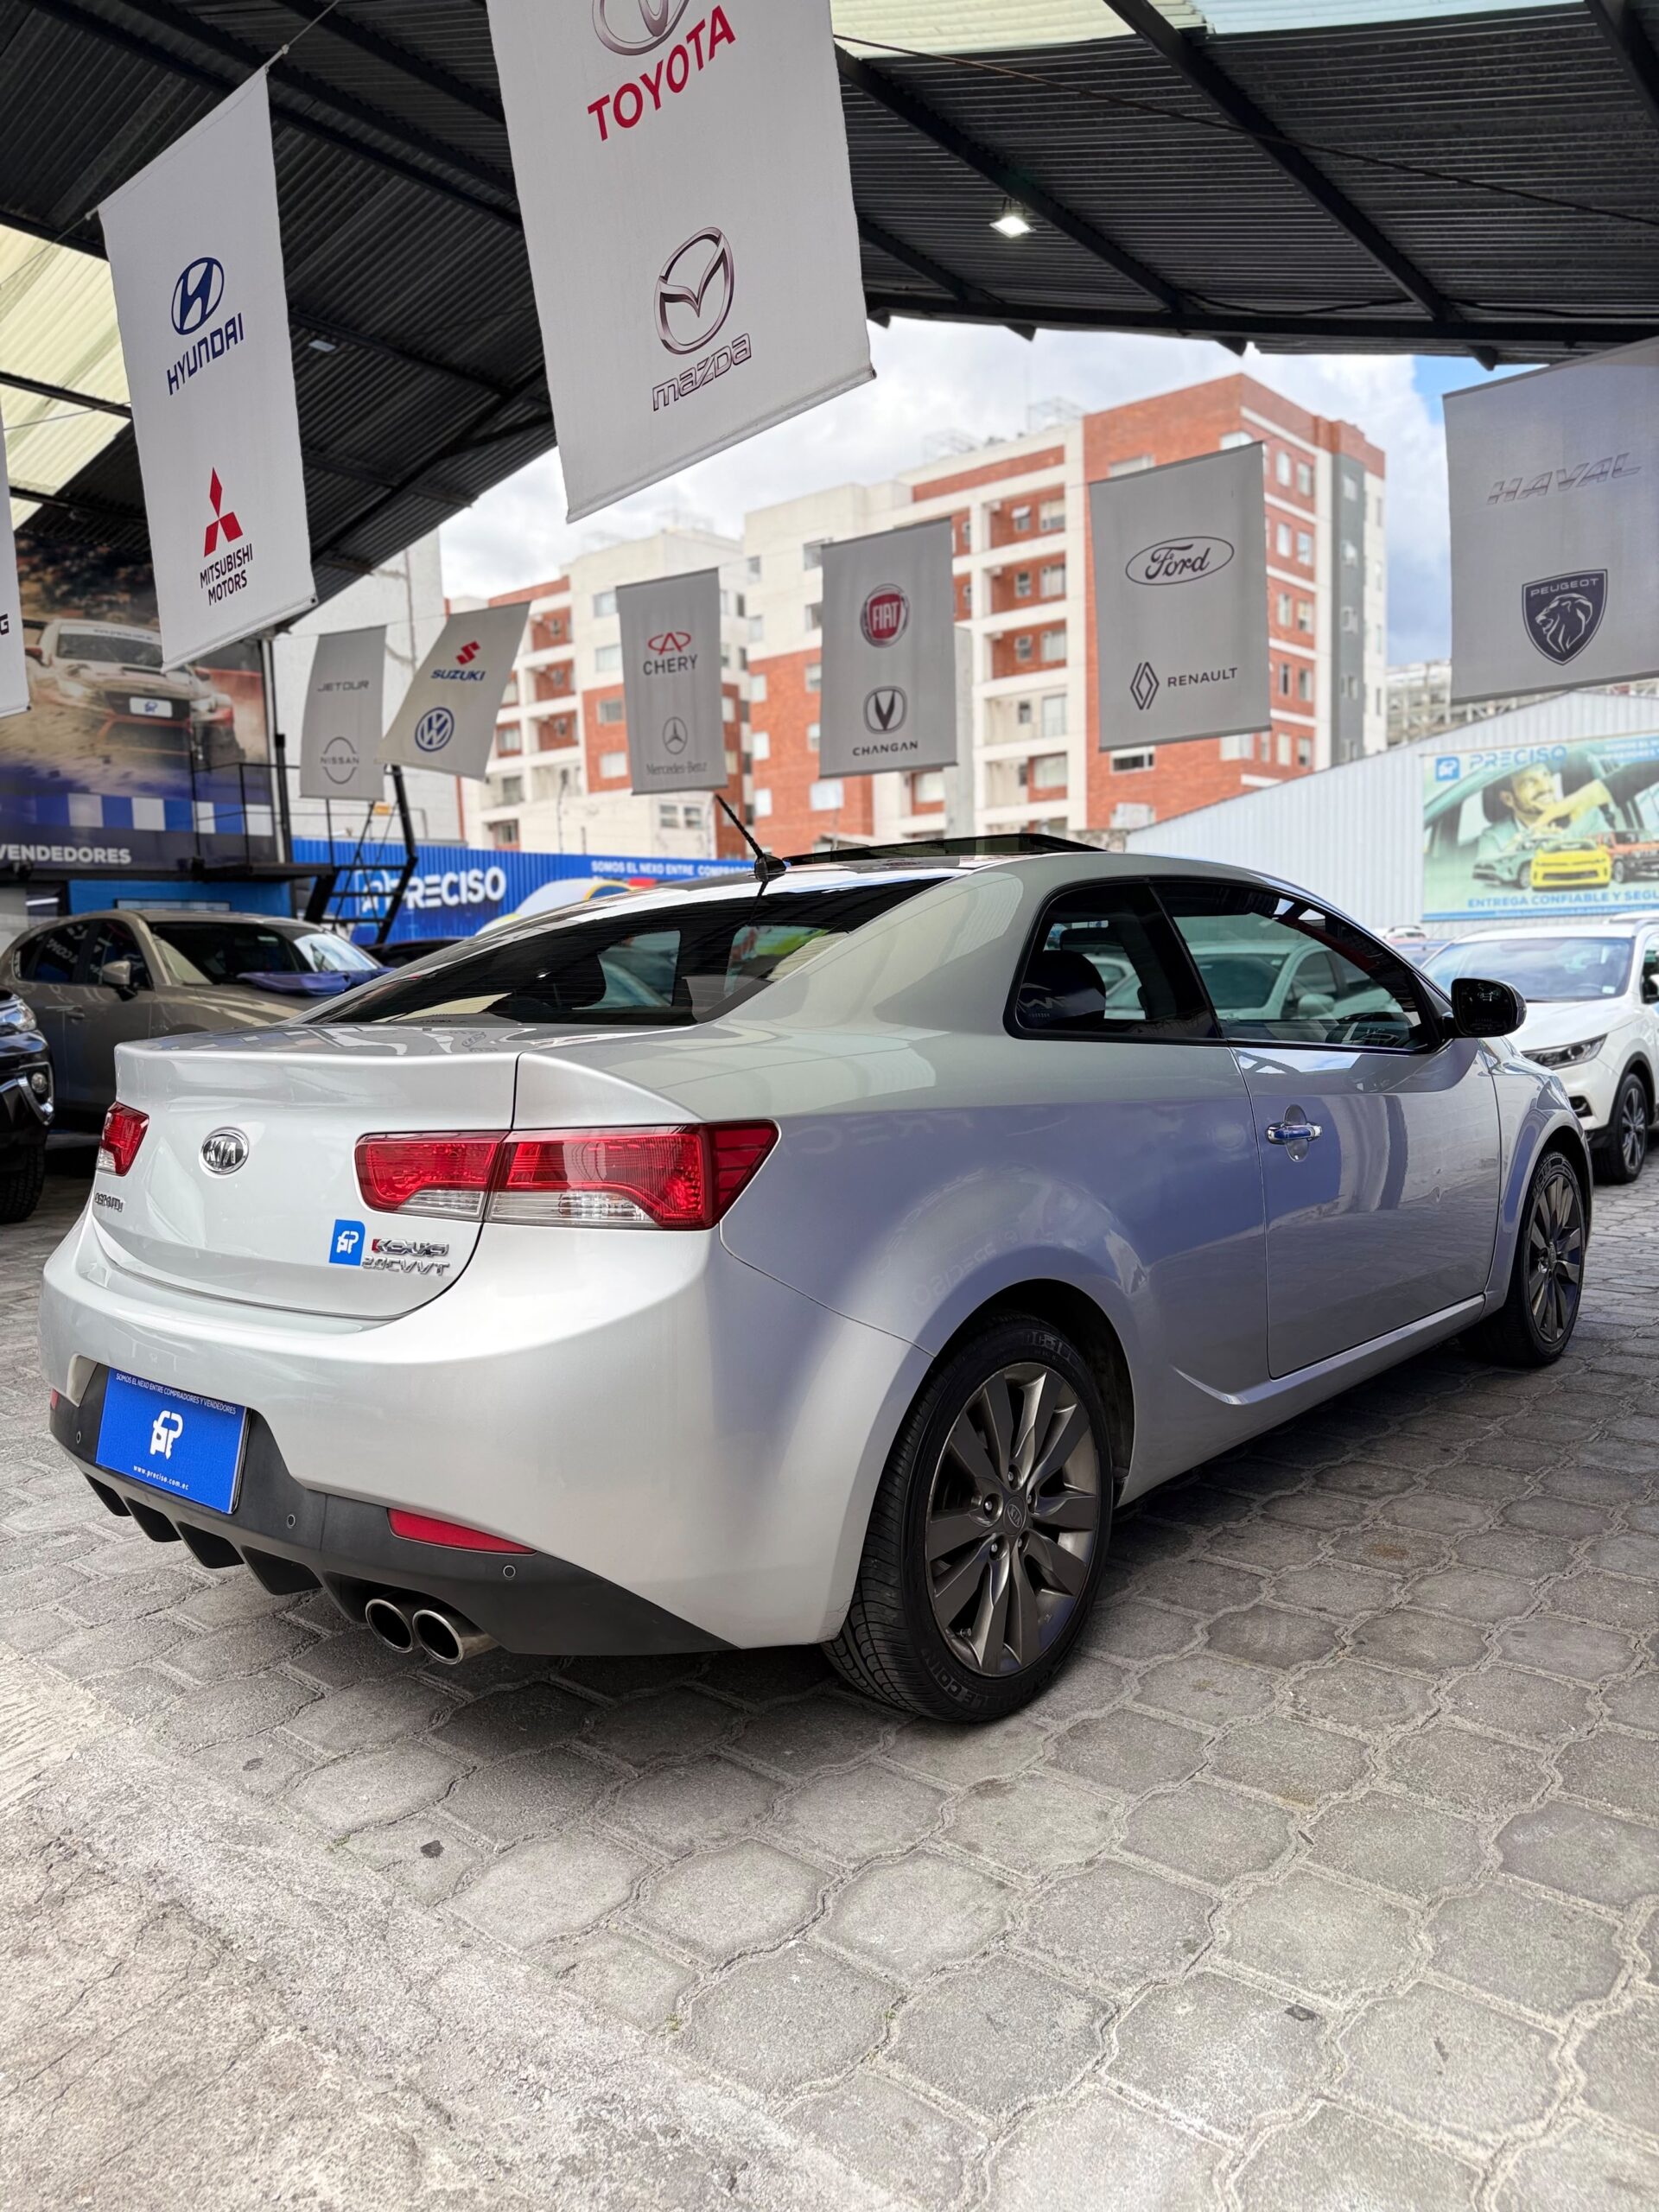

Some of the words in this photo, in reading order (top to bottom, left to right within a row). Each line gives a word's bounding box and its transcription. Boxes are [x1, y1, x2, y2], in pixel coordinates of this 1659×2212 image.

[587, 4, 736, 142] TOYOTA
[166, 312, 245, 397] HYUNDAI
[1486, 452, 1641, 505] HAVAL
[199, 543, 254, 589] MITSUBISHI
[1145, 543, 1211, 580] Ford
[207, 569, 248, 606] MOTORS
[1530, 577, 1599, 597] PEUGEOT
[871, 601, 900, 632] FIAT
[430, 668, 486, 682] SUZUKI
[643, 653, 698, 676] CHERY
[317, 679, 370, 692] JETOUR
[1167, 667, 1238, 688] RENAULT
[320, 755, 359, 766] NISSAN
[853, 741, 918, 757] CHANGAN
[1469, 745, 1567, 769] PRECISO
[591, 860, 625, 874] SOMOS
[626, 861, 639, 874] EL
[639, 862, 664, 875] NEXO
[666, 863, 695, 876] ENTRE
[1468, 896, 1528, 908] ENTREGA
[1531, 890, 1610, 906] CONFIABLE
[1612, 891, 1622, 901] Y
[116, 1372, 132, 1384] SOMOS
[131, 1376, 138, 1386] EL
[137, 1379, 149, 1389] NEXO
[149, 1382, 164, 1394] ENTRE
[163, 1387, 200, 1405] COMPRADORES
[200, 1395, 205, 1405] Y
[203, 1397, 237, 1415] VENDEDORES
[133, 1465, 189, 1491] www.preciso.com.ec
